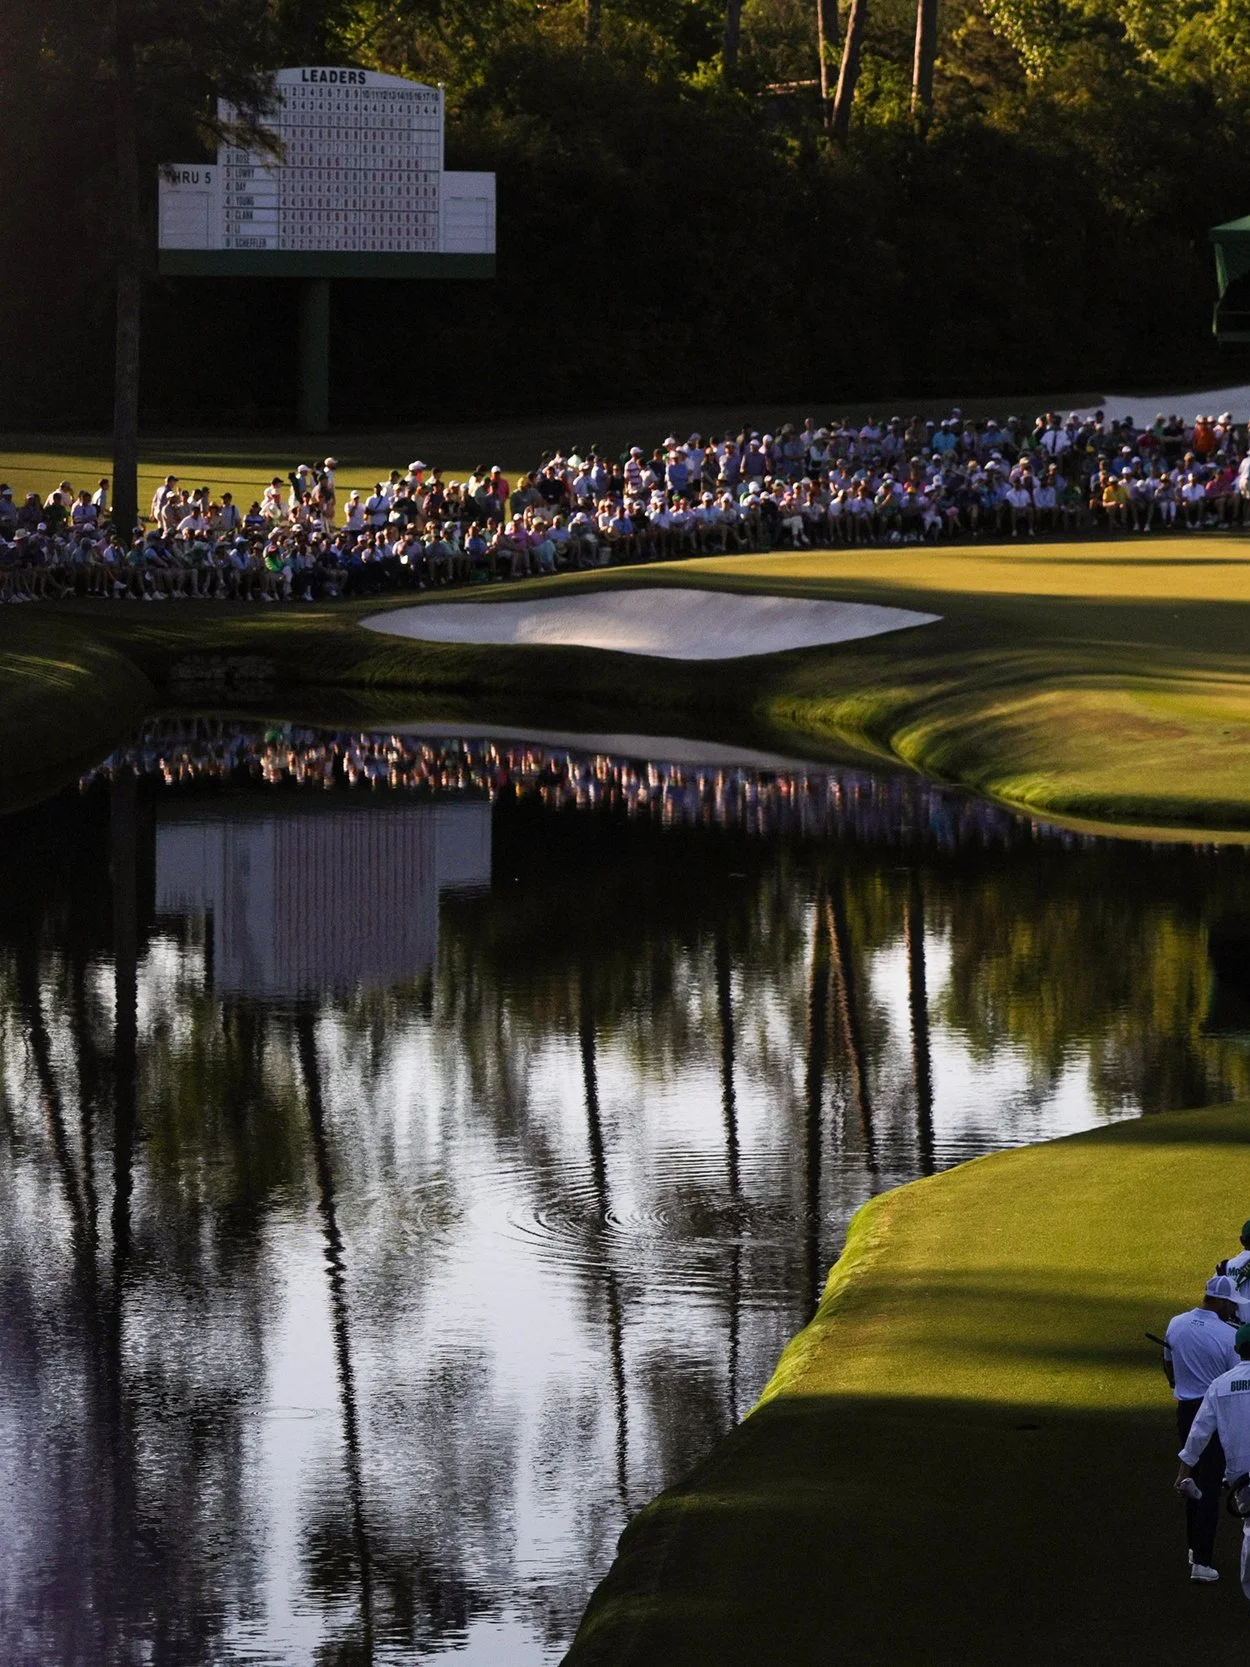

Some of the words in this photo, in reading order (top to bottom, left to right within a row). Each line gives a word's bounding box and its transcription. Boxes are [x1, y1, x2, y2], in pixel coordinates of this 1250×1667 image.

[302, 70, 366, 84] LEADERS
[205, 172, 211, 184] 5
[235, 183, 246, 191] DAY
